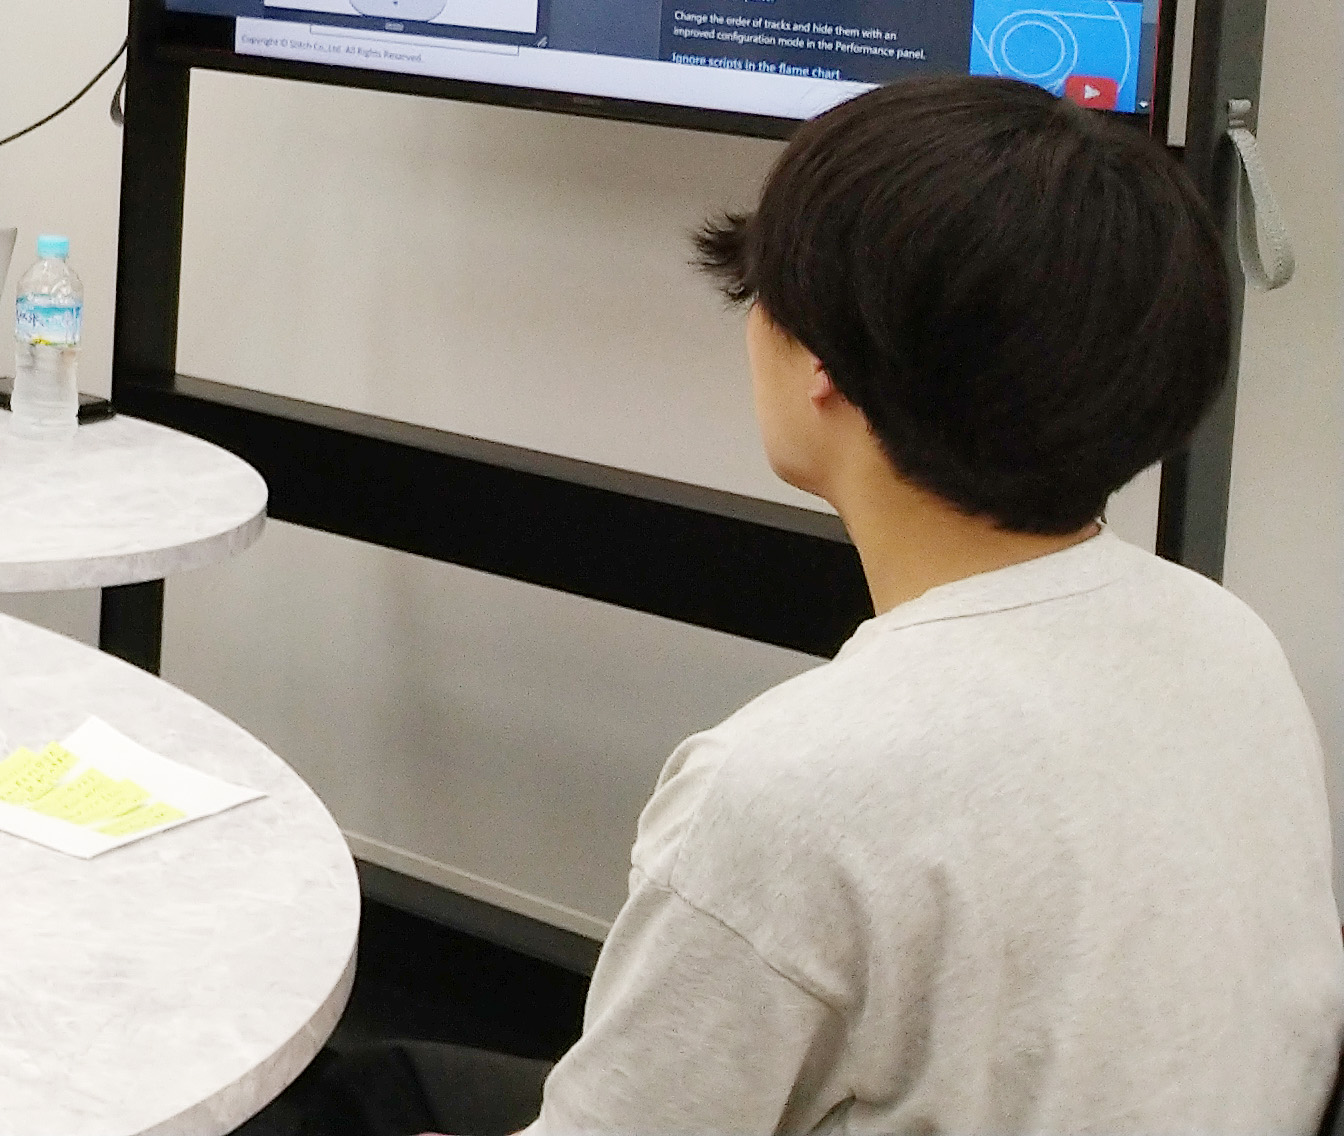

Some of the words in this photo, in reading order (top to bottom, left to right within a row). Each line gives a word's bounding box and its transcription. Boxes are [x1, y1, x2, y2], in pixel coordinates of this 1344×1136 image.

[674, 10, 707, 24] Change
[709, 13, 724, 25] the
[726, 16, 751, 28] order
[753, 17, 762, 28] of
[765, 19, 791, 31] tracks
[793, 21, 810, 33] and
[812, 22, 832, 35] hide
[835, 25, 860, 38] them
[862, 28, 882, 40] with
[884, 31, 897, 41] an
[673, 26, 715, 40] improved
[717, 29, 776, 46] configuration
[778, 36, 804, 48] mode
[807, 38, 815, 49] in
[817, 39, 833, 51] the
[835, 41, 895, 57] Performance
[896, 47, 926, 61] panel.
[672, 52, 707, 67] Ignore
[709, 56, 743, 70] scripts
[745, 59, 756, 71] in
[758, 60, 776, 73] the
[778, 62, 809, 76] flame
[812, 65, 841, 79] chart
